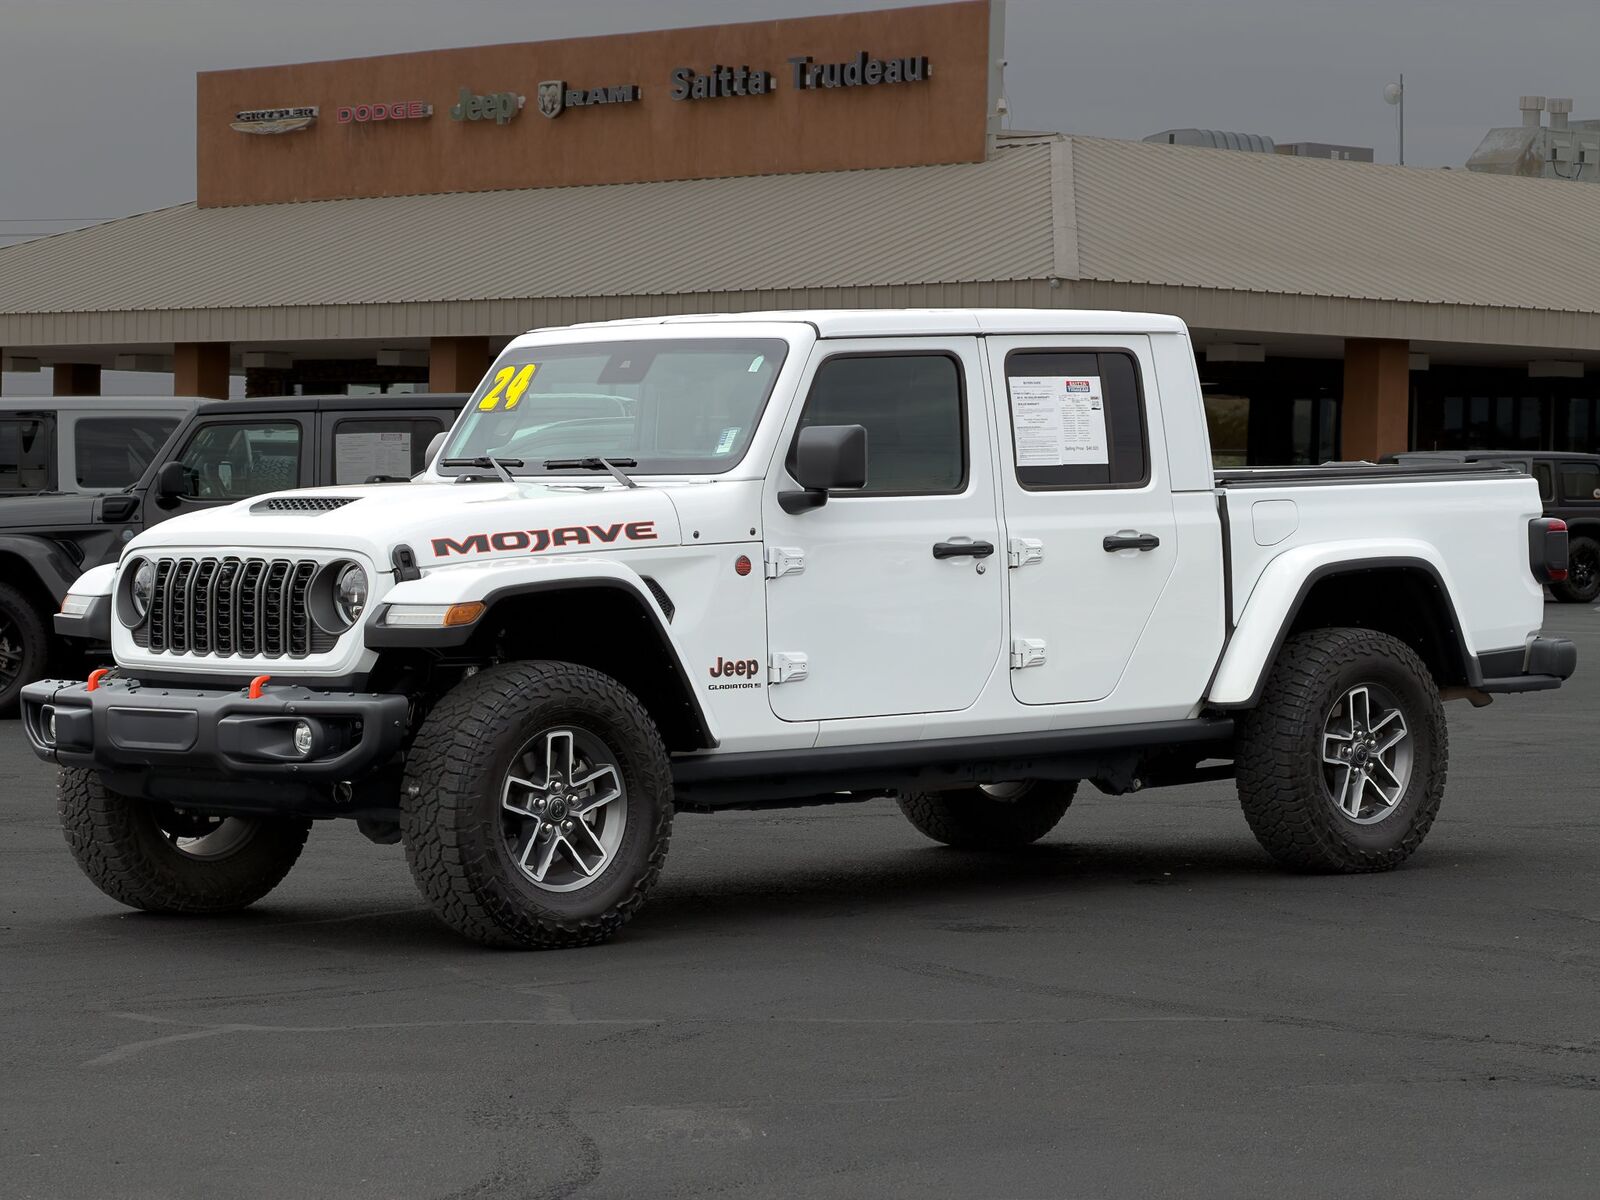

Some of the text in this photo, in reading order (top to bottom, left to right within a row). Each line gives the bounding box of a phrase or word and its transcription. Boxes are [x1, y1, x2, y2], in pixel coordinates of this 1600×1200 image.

[671, 51, 928, 101] Saitta Trudeau
[450, 87, 520, 125] Jeep
[566, 84, 638, 106] RAM
[337, 102, 427, 124] DODGE
[478, 363, 537, 412] 24
[430, 520, 658, 557] MOJAVE
[709, 656, 759, 679] Jeep
[708, 683, 754, 691] GLADIATOR
